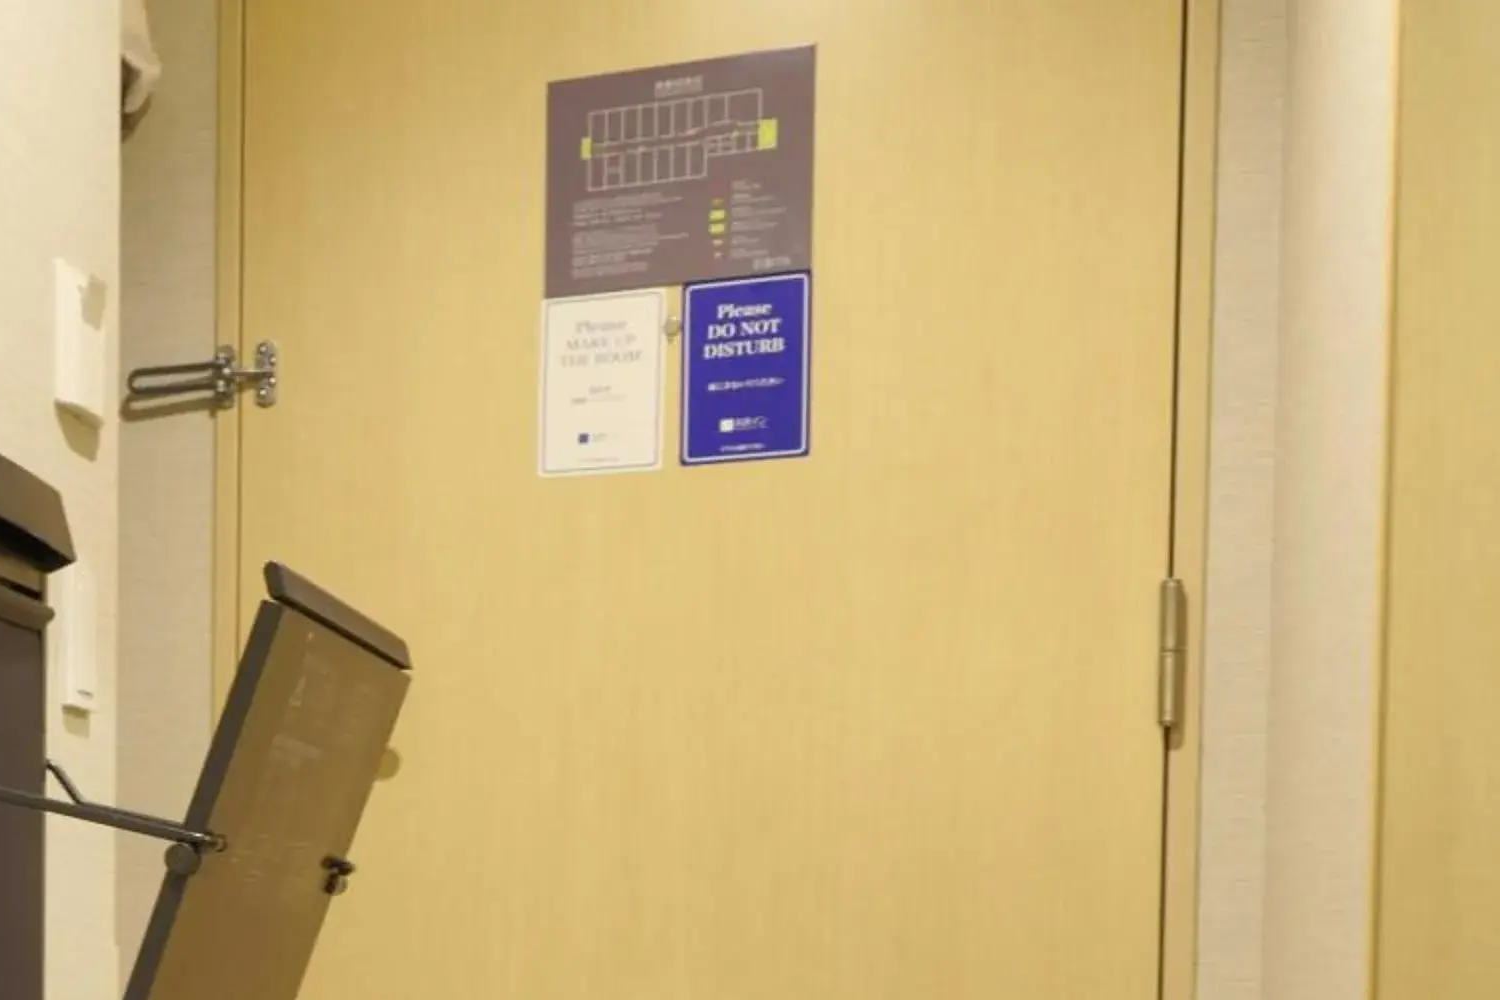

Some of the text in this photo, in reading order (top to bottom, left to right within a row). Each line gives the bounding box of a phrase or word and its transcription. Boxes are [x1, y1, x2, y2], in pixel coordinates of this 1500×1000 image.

[716, 303, 773, 319] Please
[575, 320, 628, 334] Please
[707, 318, 783, 340] DO NOT
[565, 336, 608, 349] MAKE
[703, 338, 786, 360] DISTURB
[561, 350, 644, 368] THE ROOM
